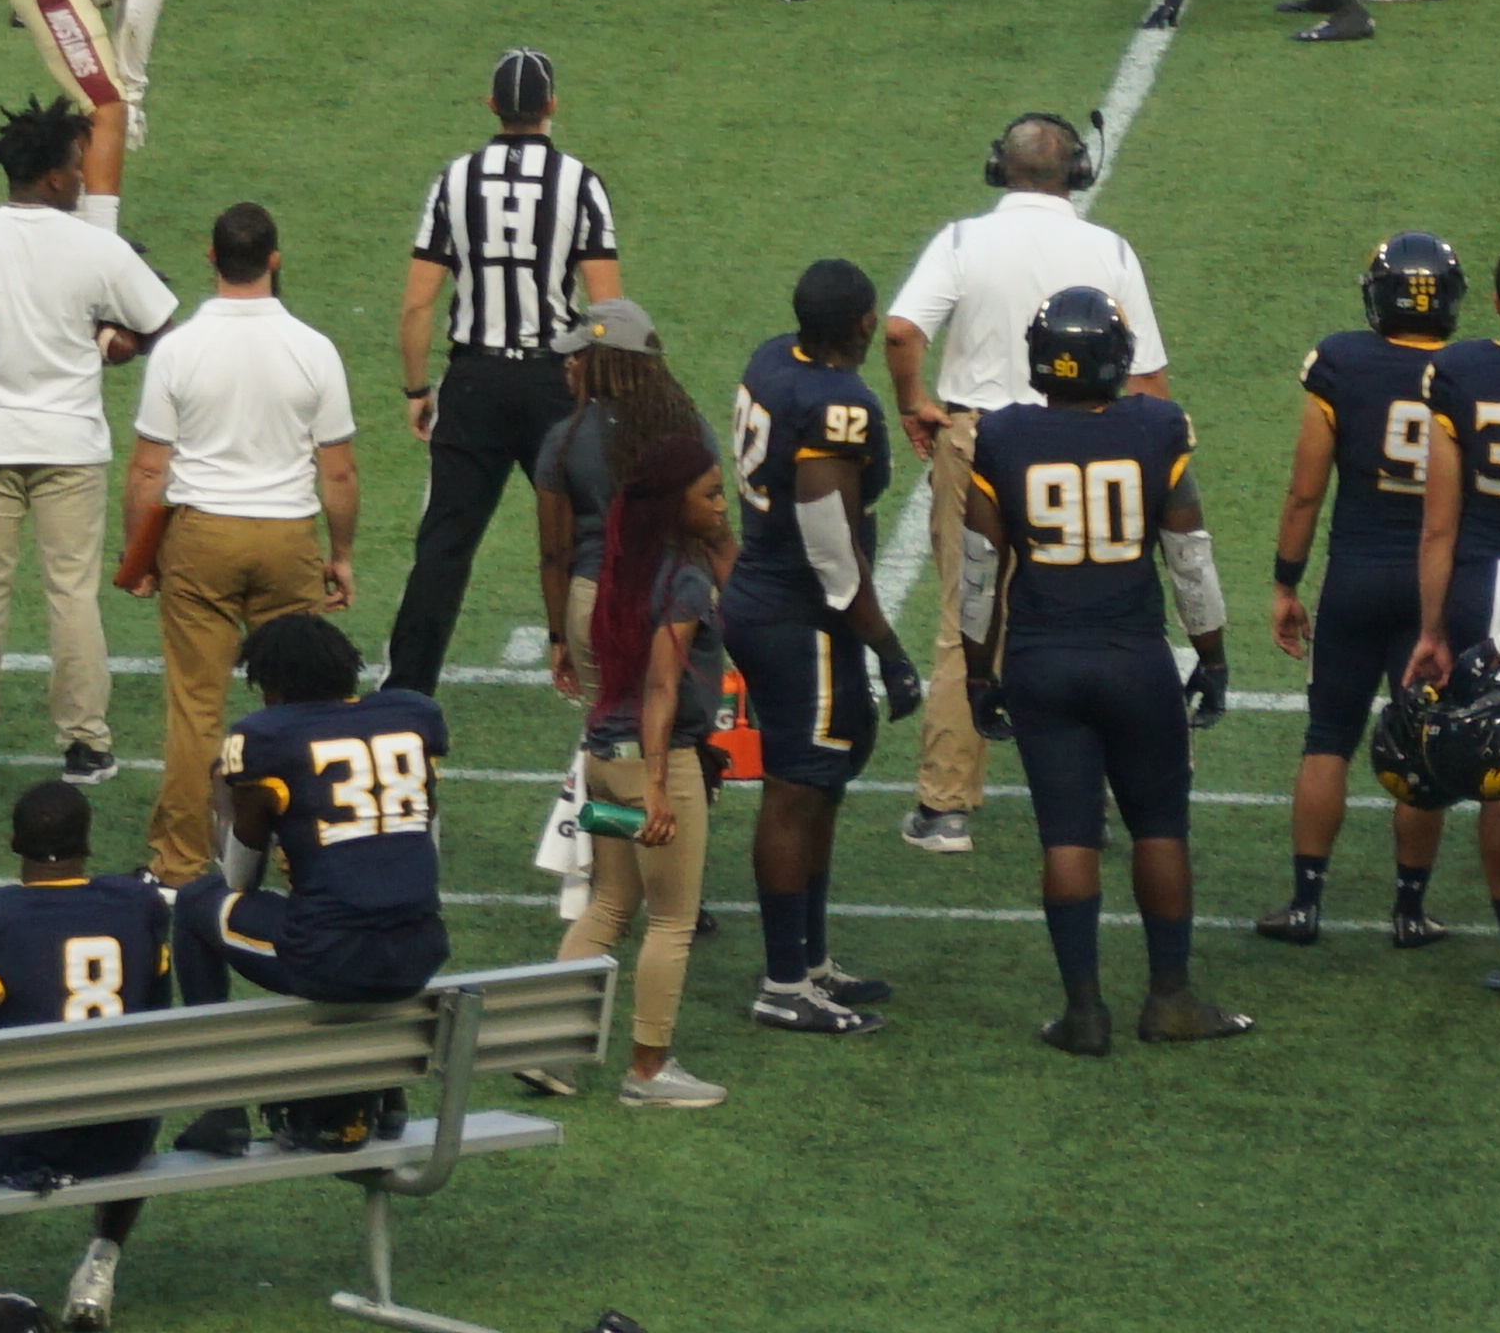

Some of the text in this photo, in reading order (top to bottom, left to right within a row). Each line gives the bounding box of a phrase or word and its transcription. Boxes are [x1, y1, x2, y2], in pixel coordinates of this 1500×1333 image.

[481, 180, 542, 261] H
[825, 405, 868, 444] 92
[1024, 461, 1143, 565] 90
[713, 709, 736, 732] G
[309, 730, 431, 846] 38
[64, 935, 123, 1023] 8
